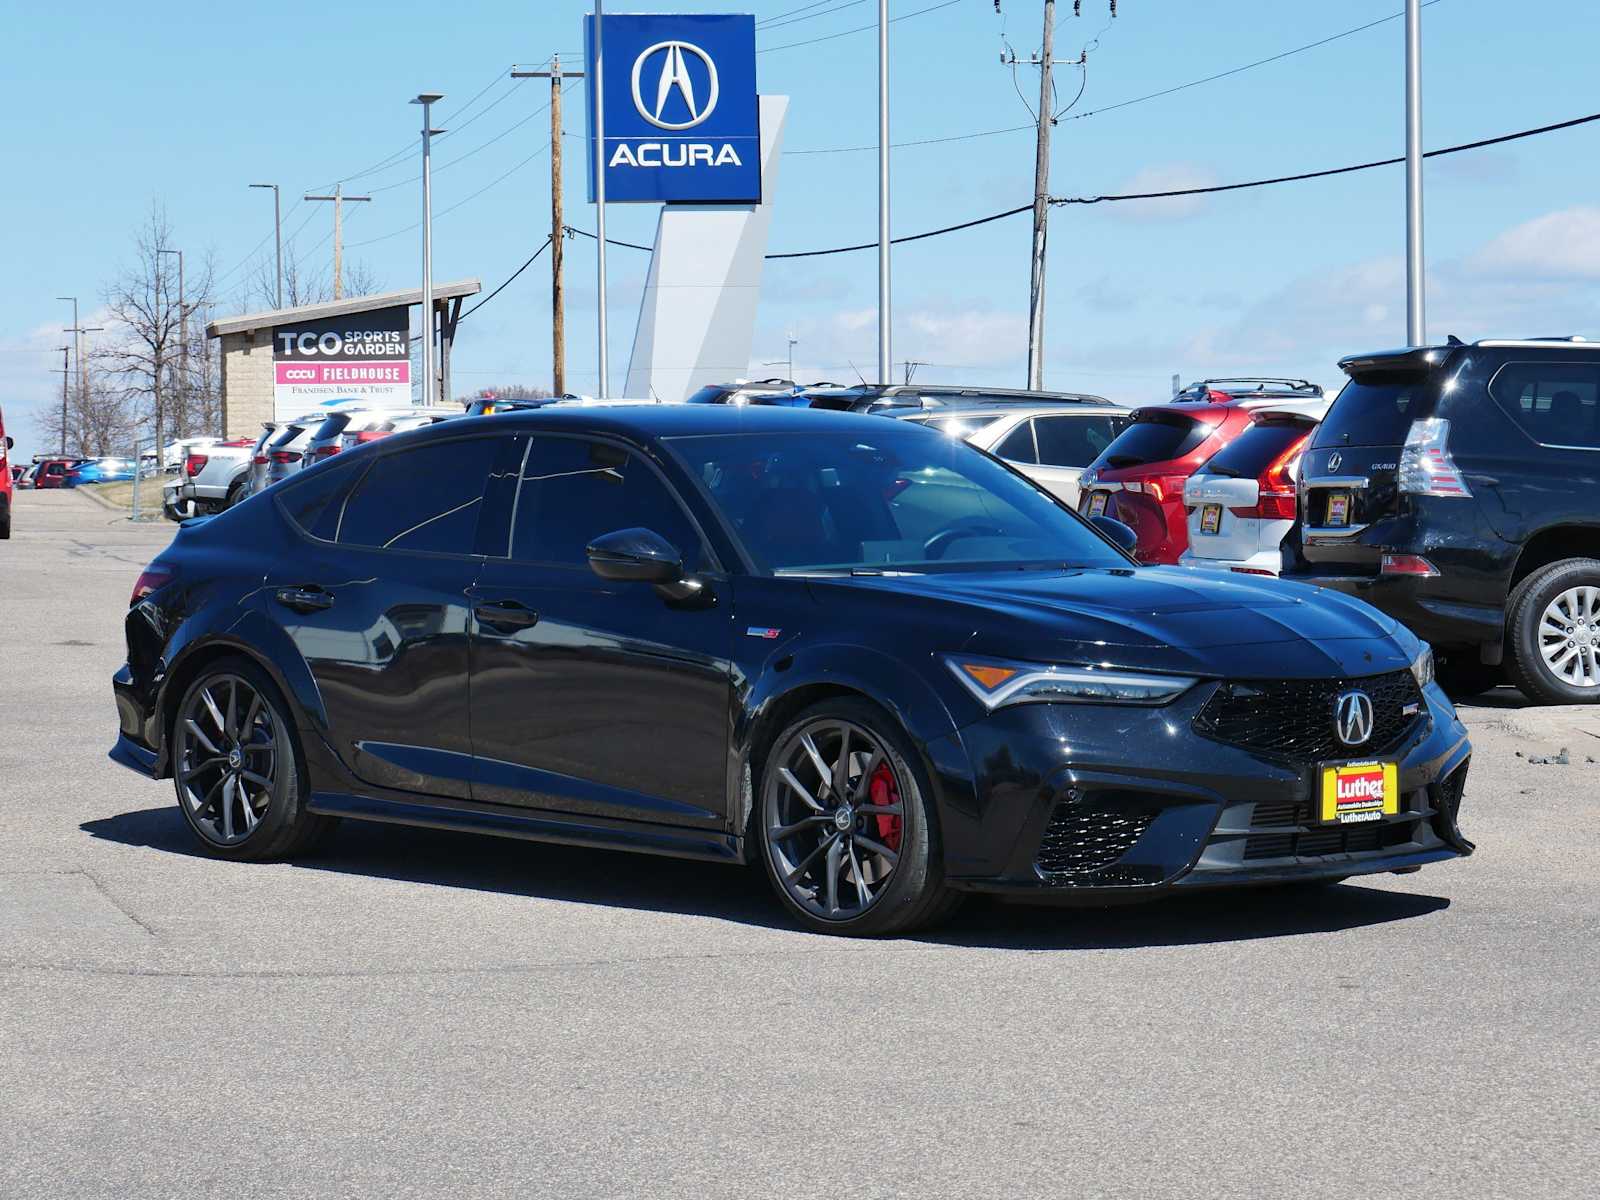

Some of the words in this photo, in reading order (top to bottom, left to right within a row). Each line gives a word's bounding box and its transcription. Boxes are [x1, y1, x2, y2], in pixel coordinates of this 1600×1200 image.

[609, 143, 742, 167] ACURA
[344, 331, 400, 342] SPORTS
[278, 331, 342, 356] TCO
[344, 343, 405, 355] GARDEN
[323, 367, 400, 380] FIELDHOUSE
[369, 385, 393, 394] TRUST
[1337, 777, 1384, 799] Luther
[1340, 811, 1382, 824] LutherAuto
